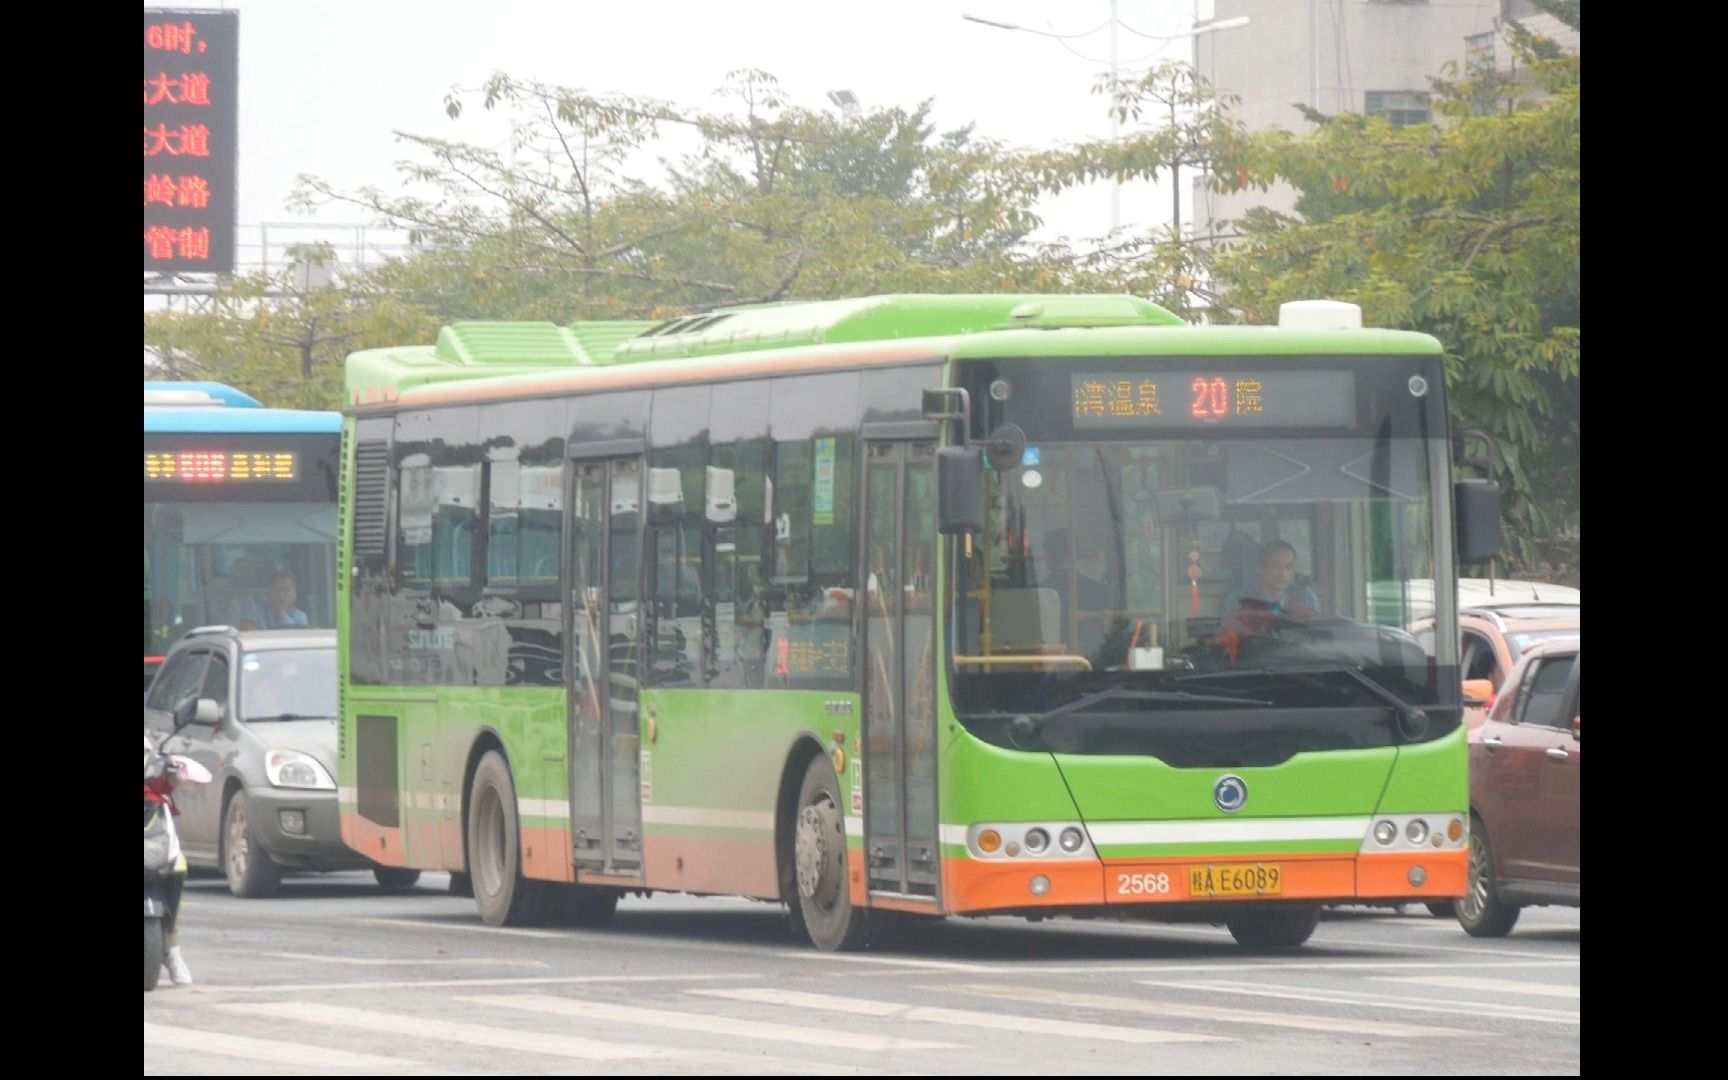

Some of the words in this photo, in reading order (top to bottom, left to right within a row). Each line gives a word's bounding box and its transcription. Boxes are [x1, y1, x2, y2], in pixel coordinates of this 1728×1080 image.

[144, 72, 211, 106] 大道
[144, 123, 211, 157] 大道
[144, 226, 209, 260] 管制
[1191, 376, 1228, 417] 20
[1236, 378, 1263, 415] 院
[1117, 873, 1170, 895] 2568
